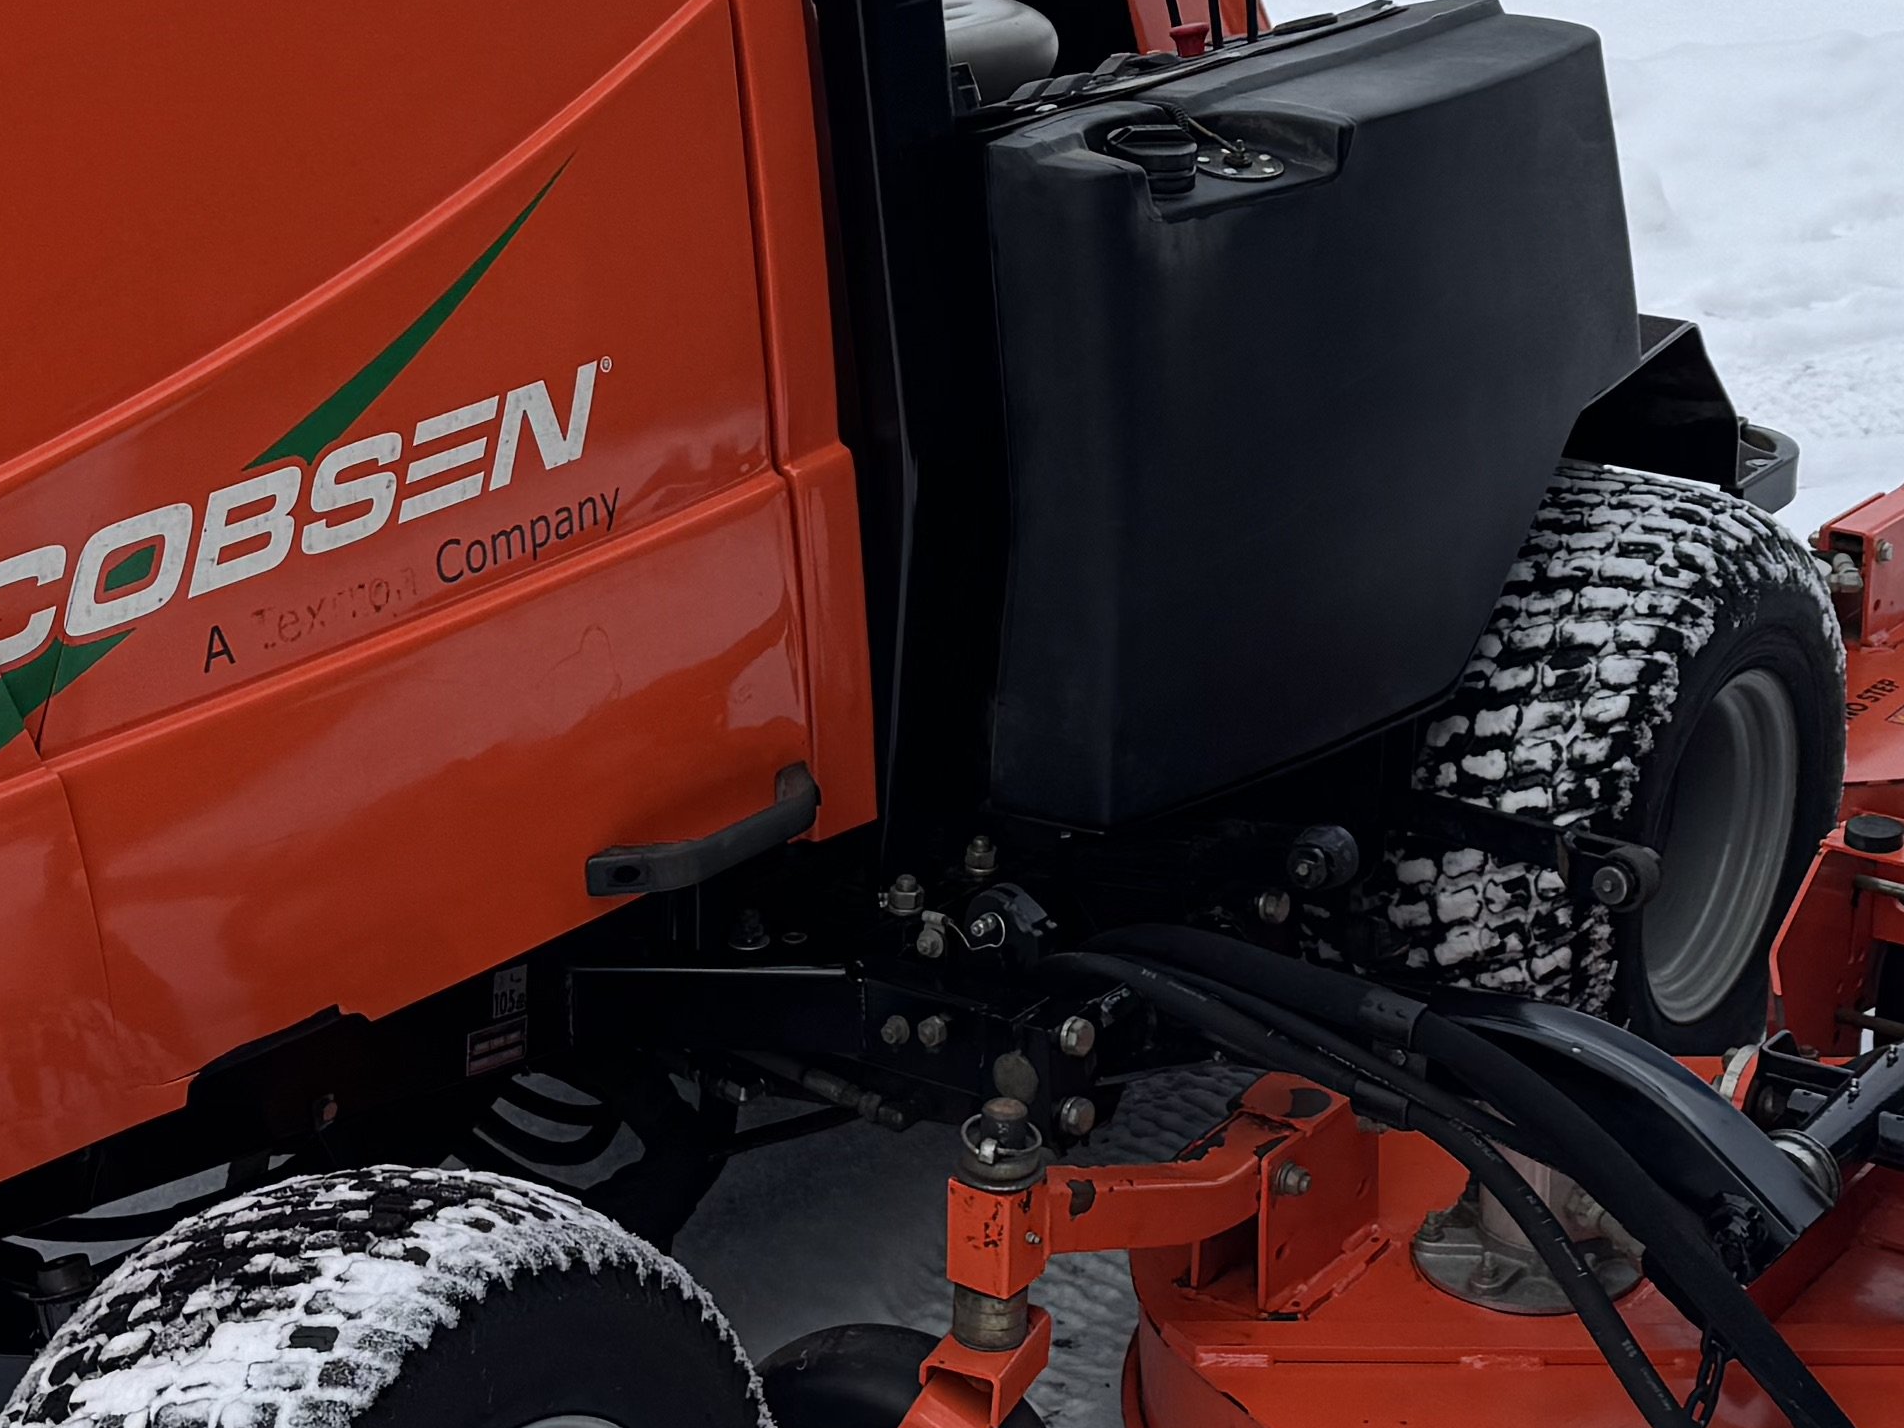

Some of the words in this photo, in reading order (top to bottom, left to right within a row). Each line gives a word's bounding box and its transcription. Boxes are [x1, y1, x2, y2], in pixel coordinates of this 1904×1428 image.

[203, 624, 237, 674] A
[435, 487, 621, 585] Company
[1856, 678, 1900, 703] STEP
